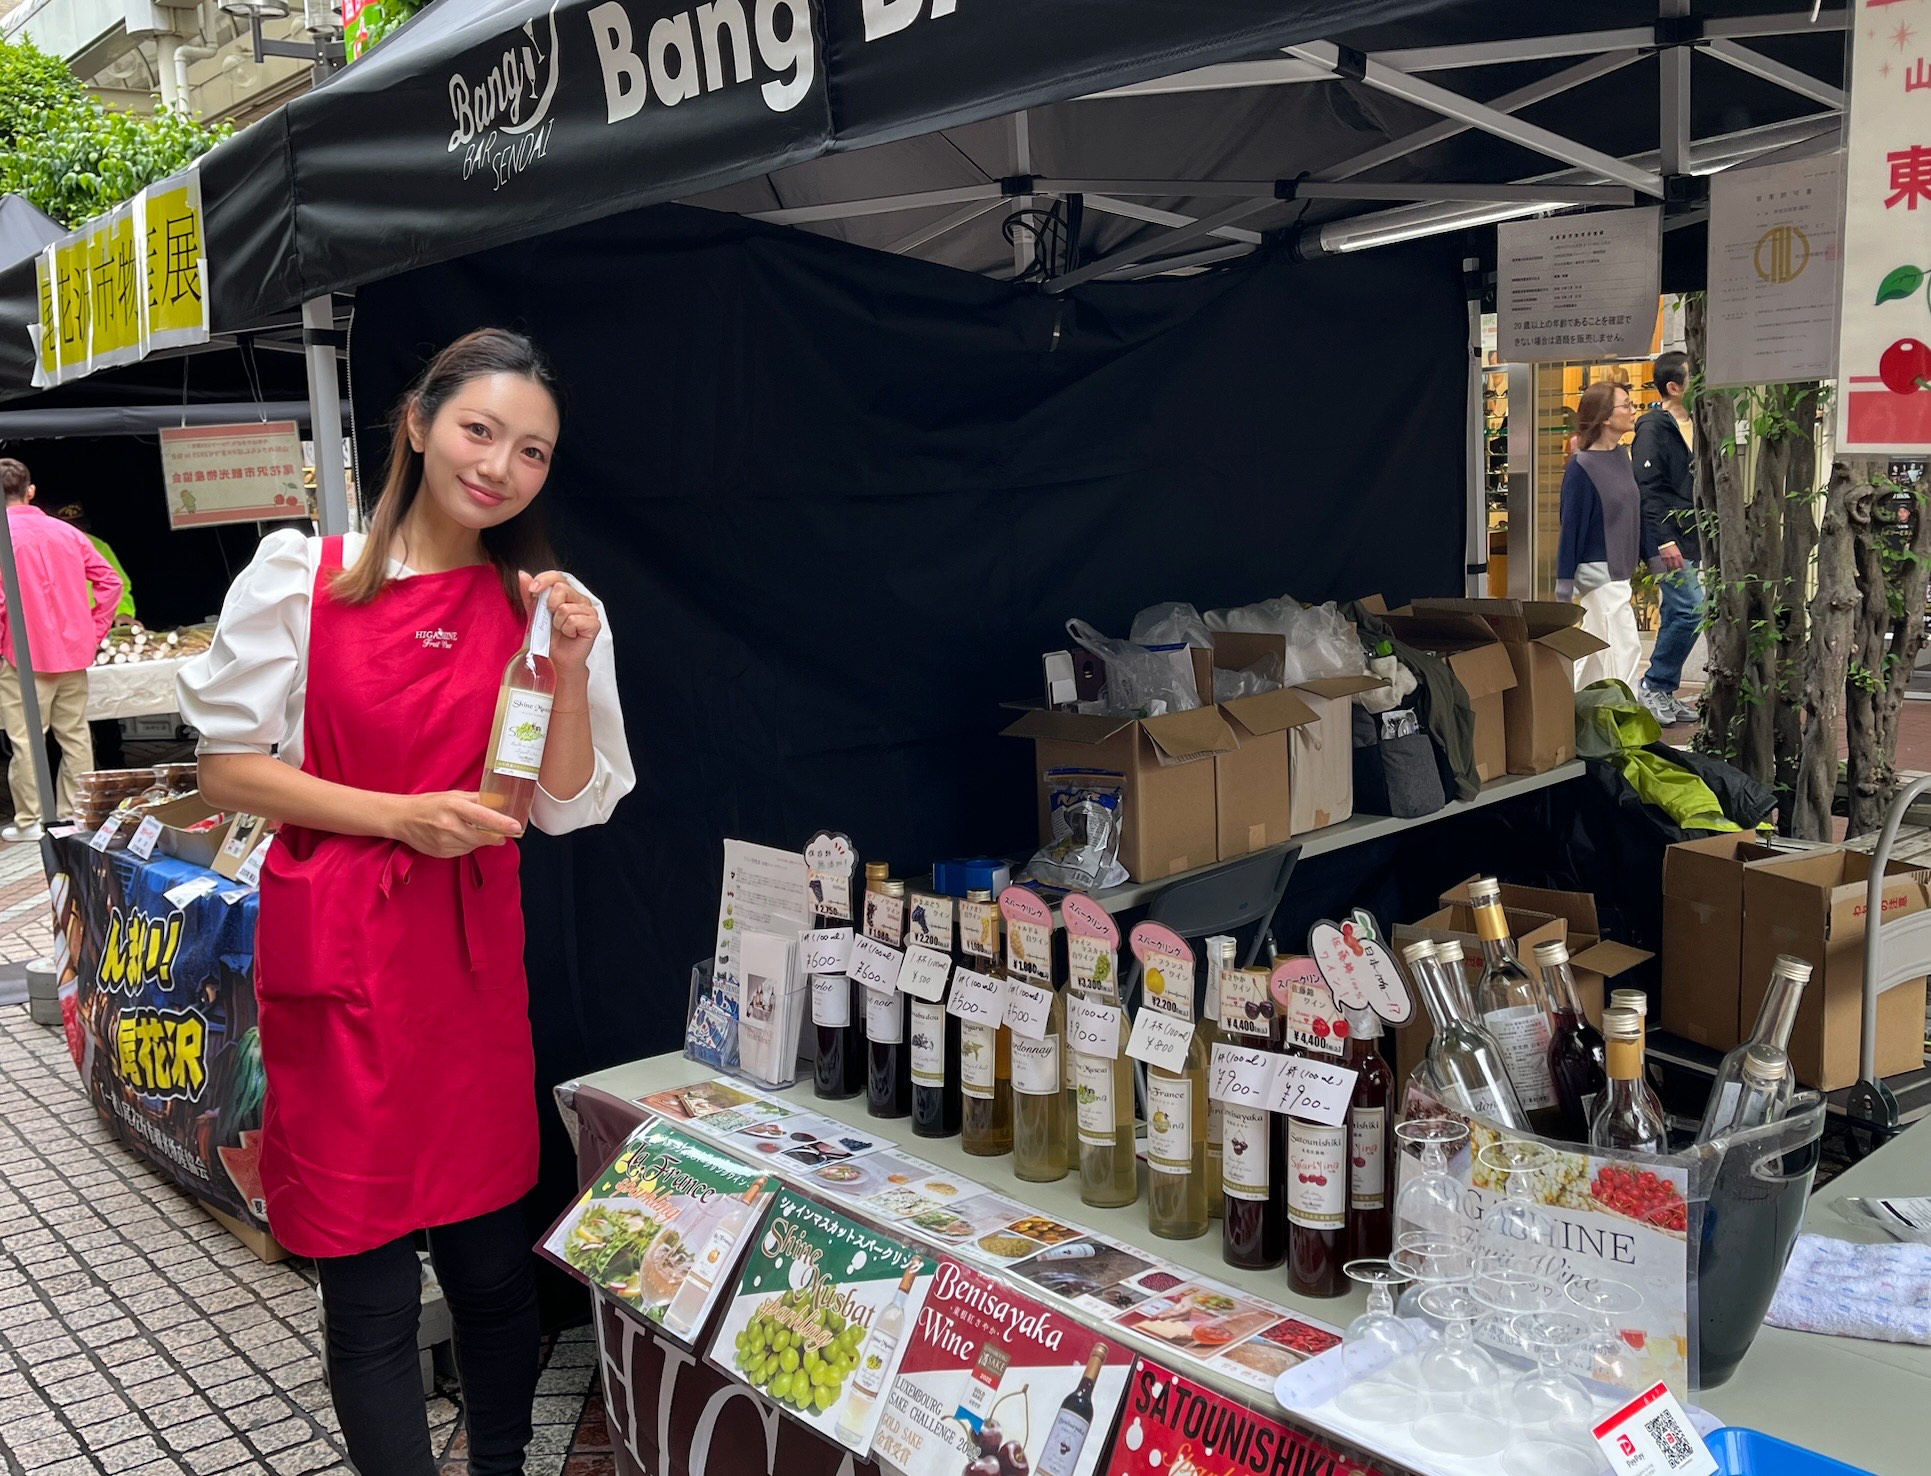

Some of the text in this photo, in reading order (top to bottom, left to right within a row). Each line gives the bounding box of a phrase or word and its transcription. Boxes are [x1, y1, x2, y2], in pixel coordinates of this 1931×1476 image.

[587, 0, 815, 124] Bang
[462, 117, 556, 192] BAR SENDAI
[1004, 897, 1044, 918] スパークリング
[1068, 902, 1111, 934] スパークリング
[1137, 933, 1182, 957] スパークリング
[1151, 995, 1177, 1013] ¥2,200
[1232, 983, 1252, 993] ワイン
[1303, 997, 1326, 1008] ワイン
[1226, 1017, 1255, 1033] ¥4,400
[1293, 1030, 1327, 1049] ¥4,400
[118, 1010, 206, 1099] 尾花沢
[1146, 1036, 1174, 1053] ¥800
[640, 1153, 717, 1204] France
[761, 1217, 824, 1267] Shine
[933, 1261, 1064, 1352] Benisayaka
[918, 1306, 975, 1361] Wine
[895, 1377, 943, 1417] LUXEMBOURG
[881, 1412, 924, 1451] GOLD SAKE
[888, 1392, 907, 1415] SAKE
[908, 1406, 957, 1446] CHALLENGE
[1135, 1370, 1336, 1476] SATOUNISHIKI
[877, 1429, 913, 1467] 金賞受賞
[1626, 1452, 1645, 1468] PayPay
